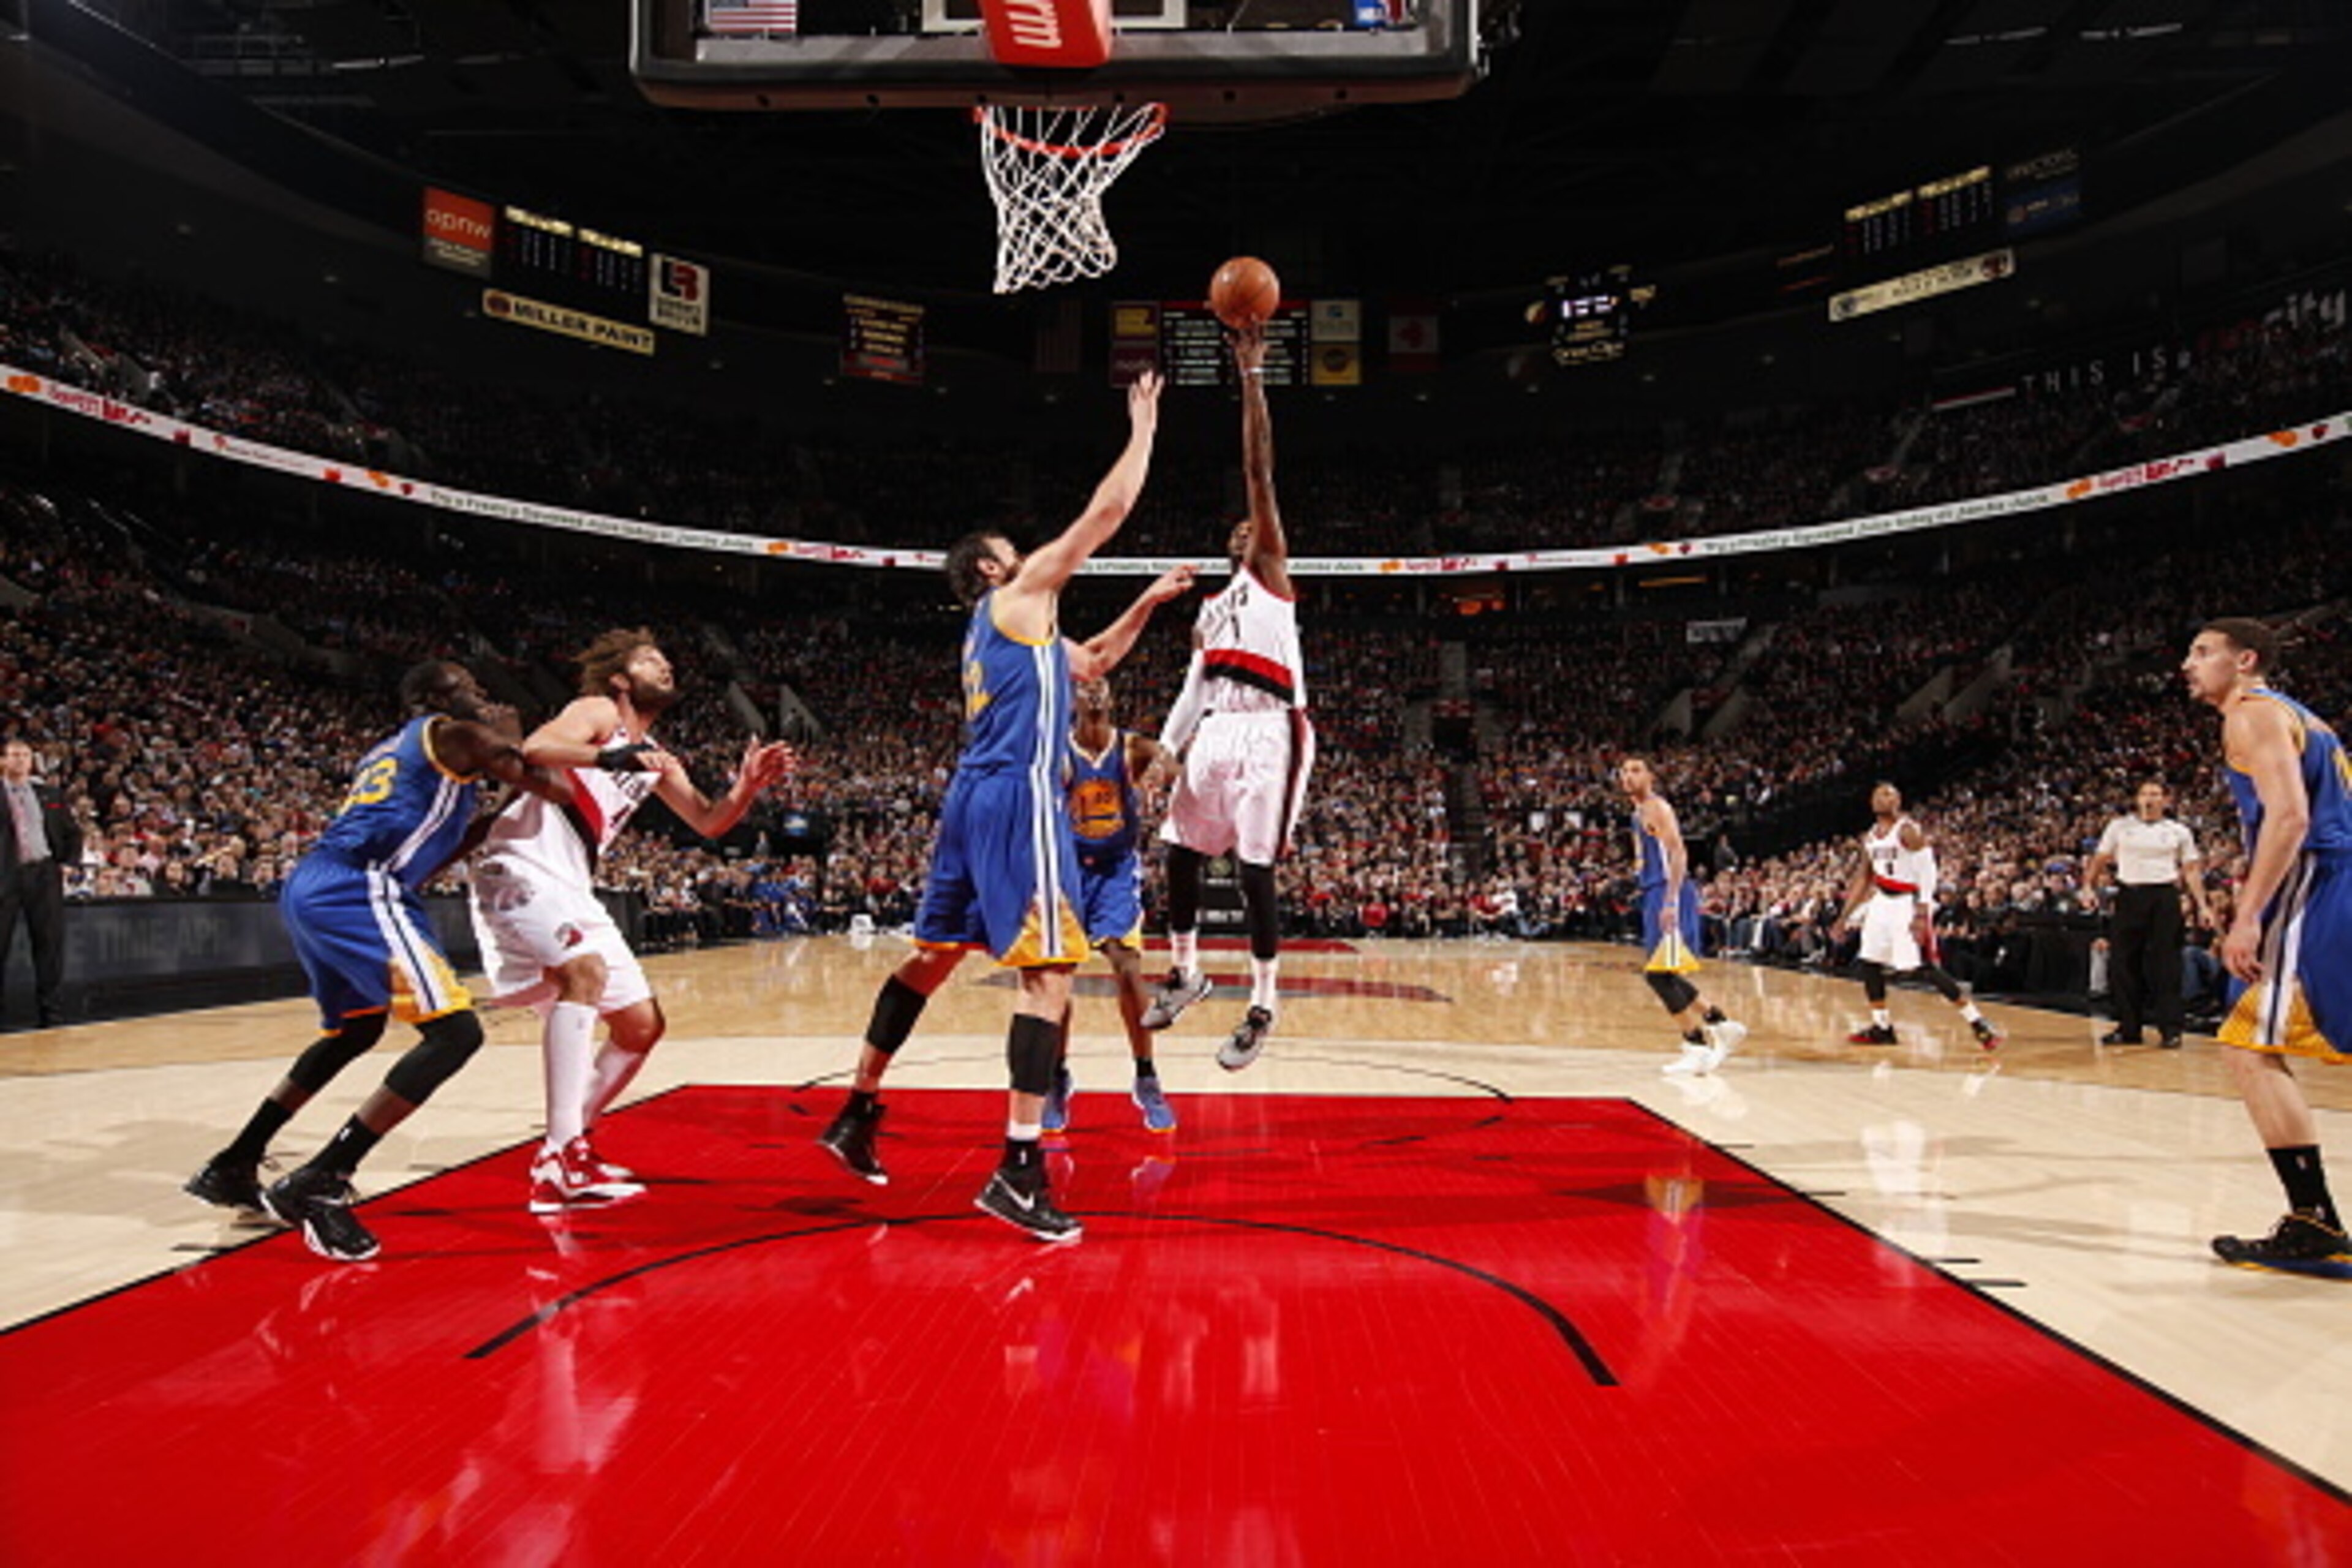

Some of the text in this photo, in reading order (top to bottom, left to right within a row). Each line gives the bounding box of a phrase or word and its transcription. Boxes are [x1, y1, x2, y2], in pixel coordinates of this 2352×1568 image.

[514, 300, 651, 349] MILLER PAINT
[2022, 360, 2103, 393] THIS
[2133, 347, 2166, 375] IS
